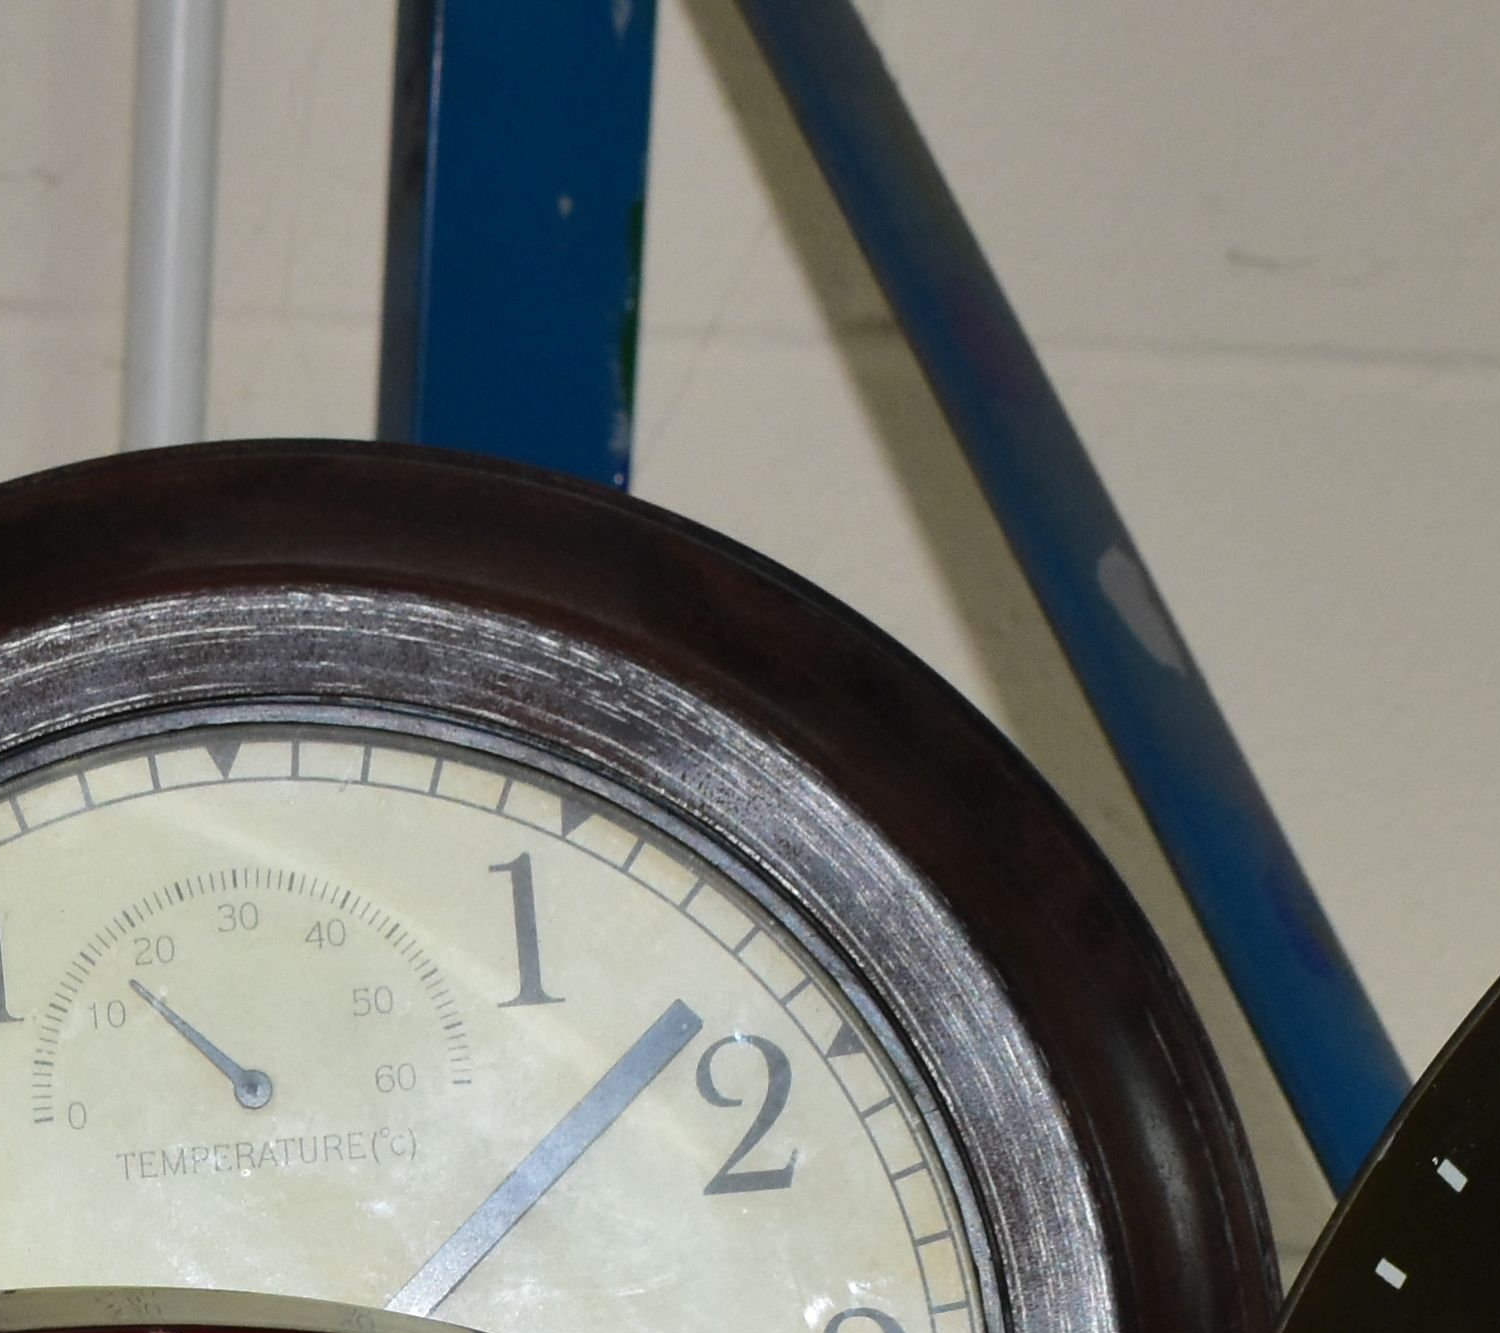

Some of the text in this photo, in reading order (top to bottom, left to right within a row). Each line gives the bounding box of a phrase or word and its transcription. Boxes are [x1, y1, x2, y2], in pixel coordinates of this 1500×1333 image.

[217, 902, 260, 932] 30
[487, 851, 566, 1008] 1
[305, 919, 347, 948] 40
[134, 935, 175, 966] 20
[91, 1000, 127, 1029] 10
[352, 985, 394, 1018] 50
[374, 1063, 417, 1094] 60
[67, 1103, 87, 1130] 0
[693, 1033, 800, 1197] 2
